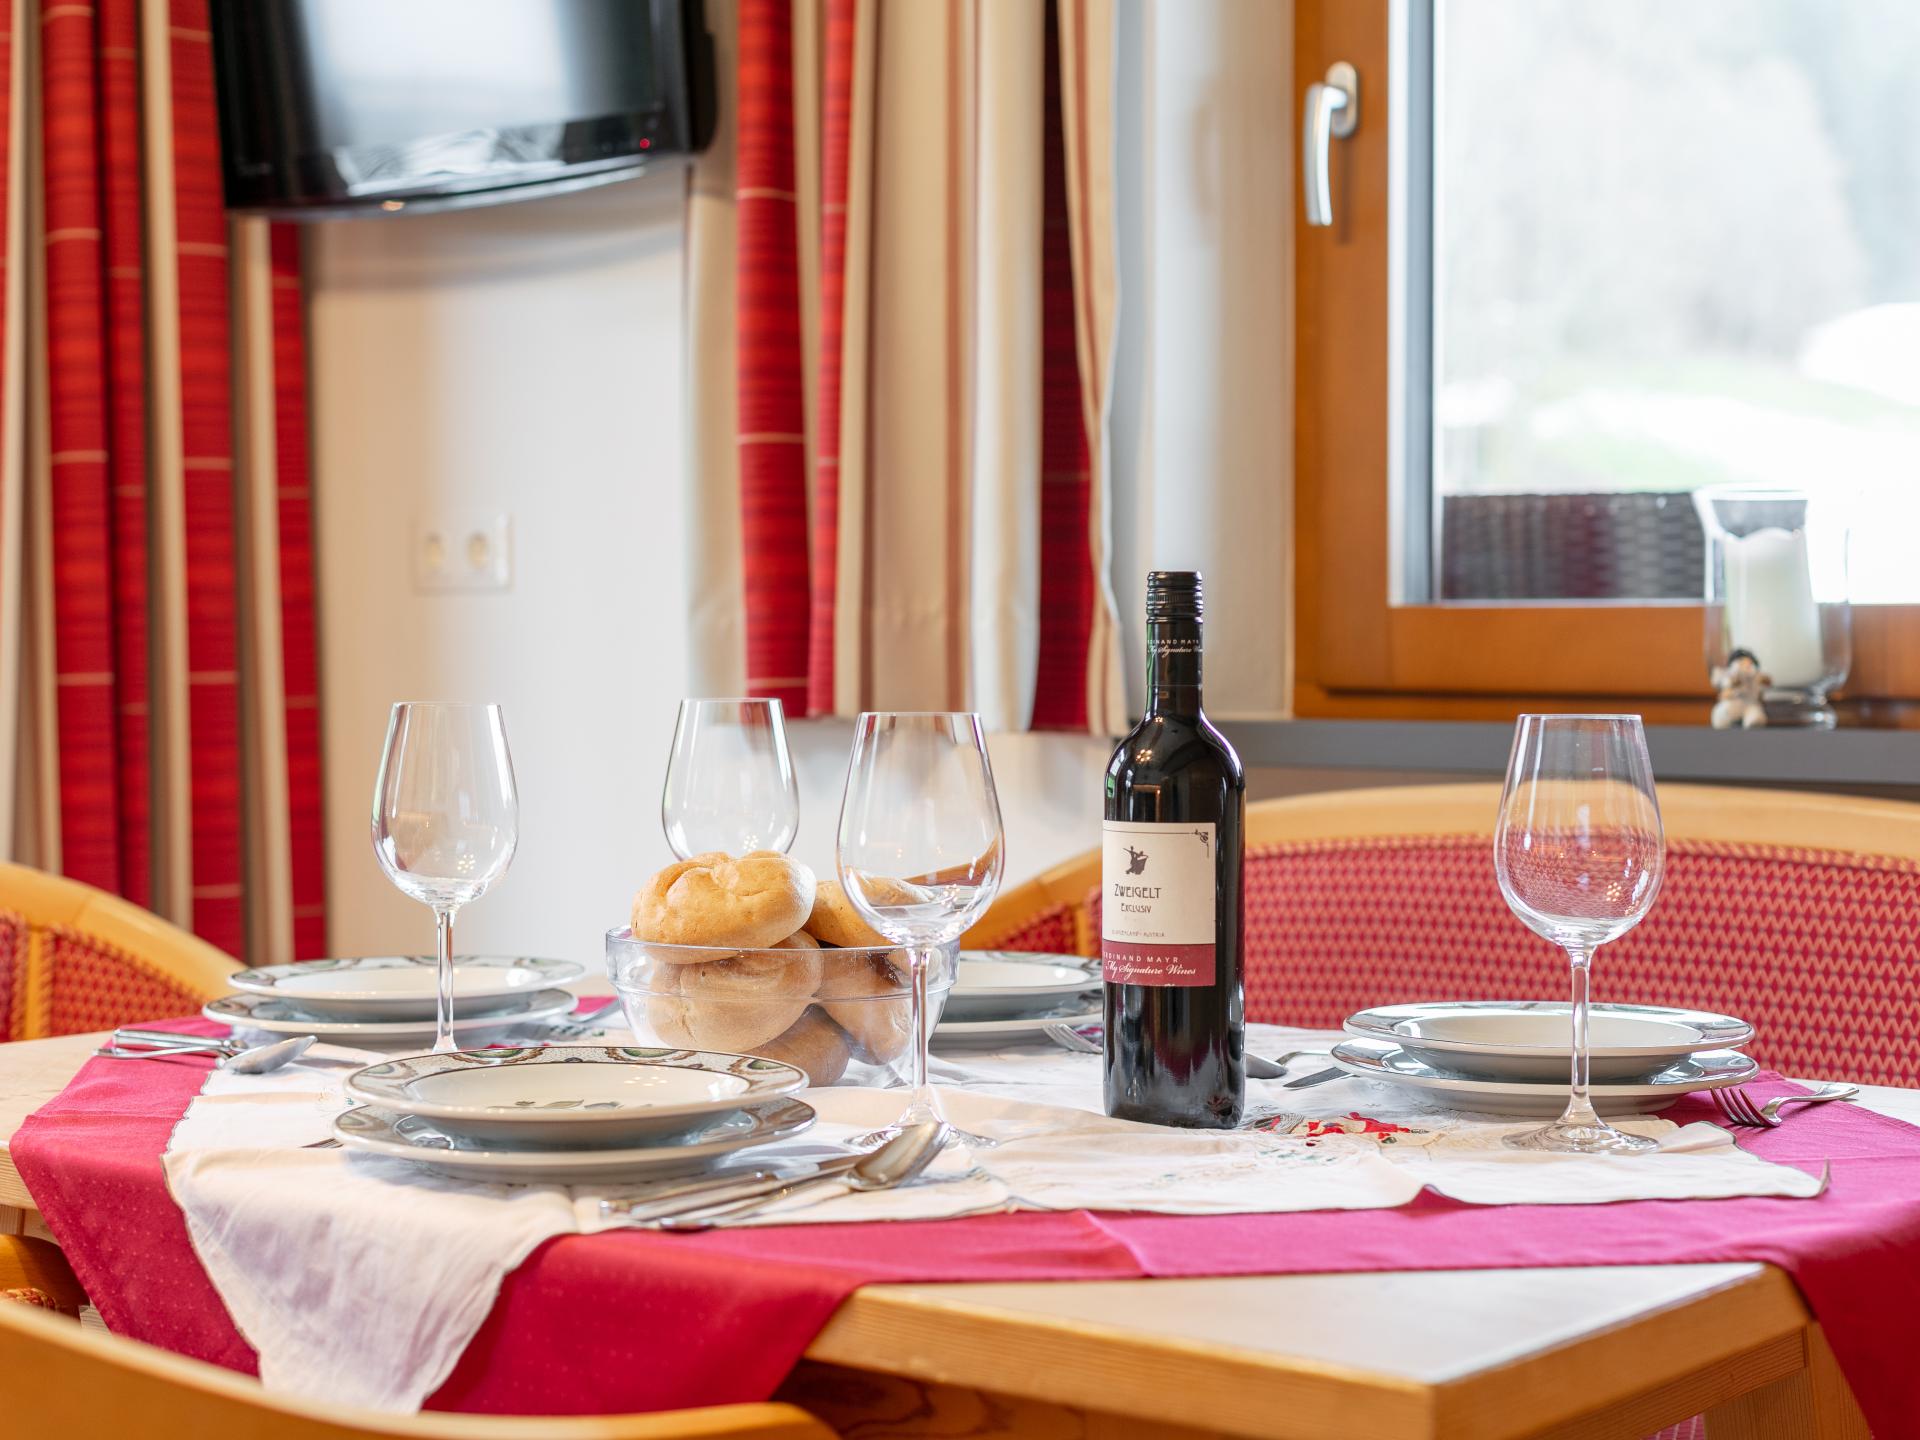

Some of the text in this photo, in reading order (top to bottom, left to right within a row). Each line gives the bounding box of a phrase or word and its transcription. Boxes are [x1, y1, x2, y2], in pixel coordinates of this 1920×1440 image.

[1114, 883, 1162, 899] ZWEIGELT
[1119, 963, 1163, 980] Signature
[1165, 963, 1196, 975] Wines
